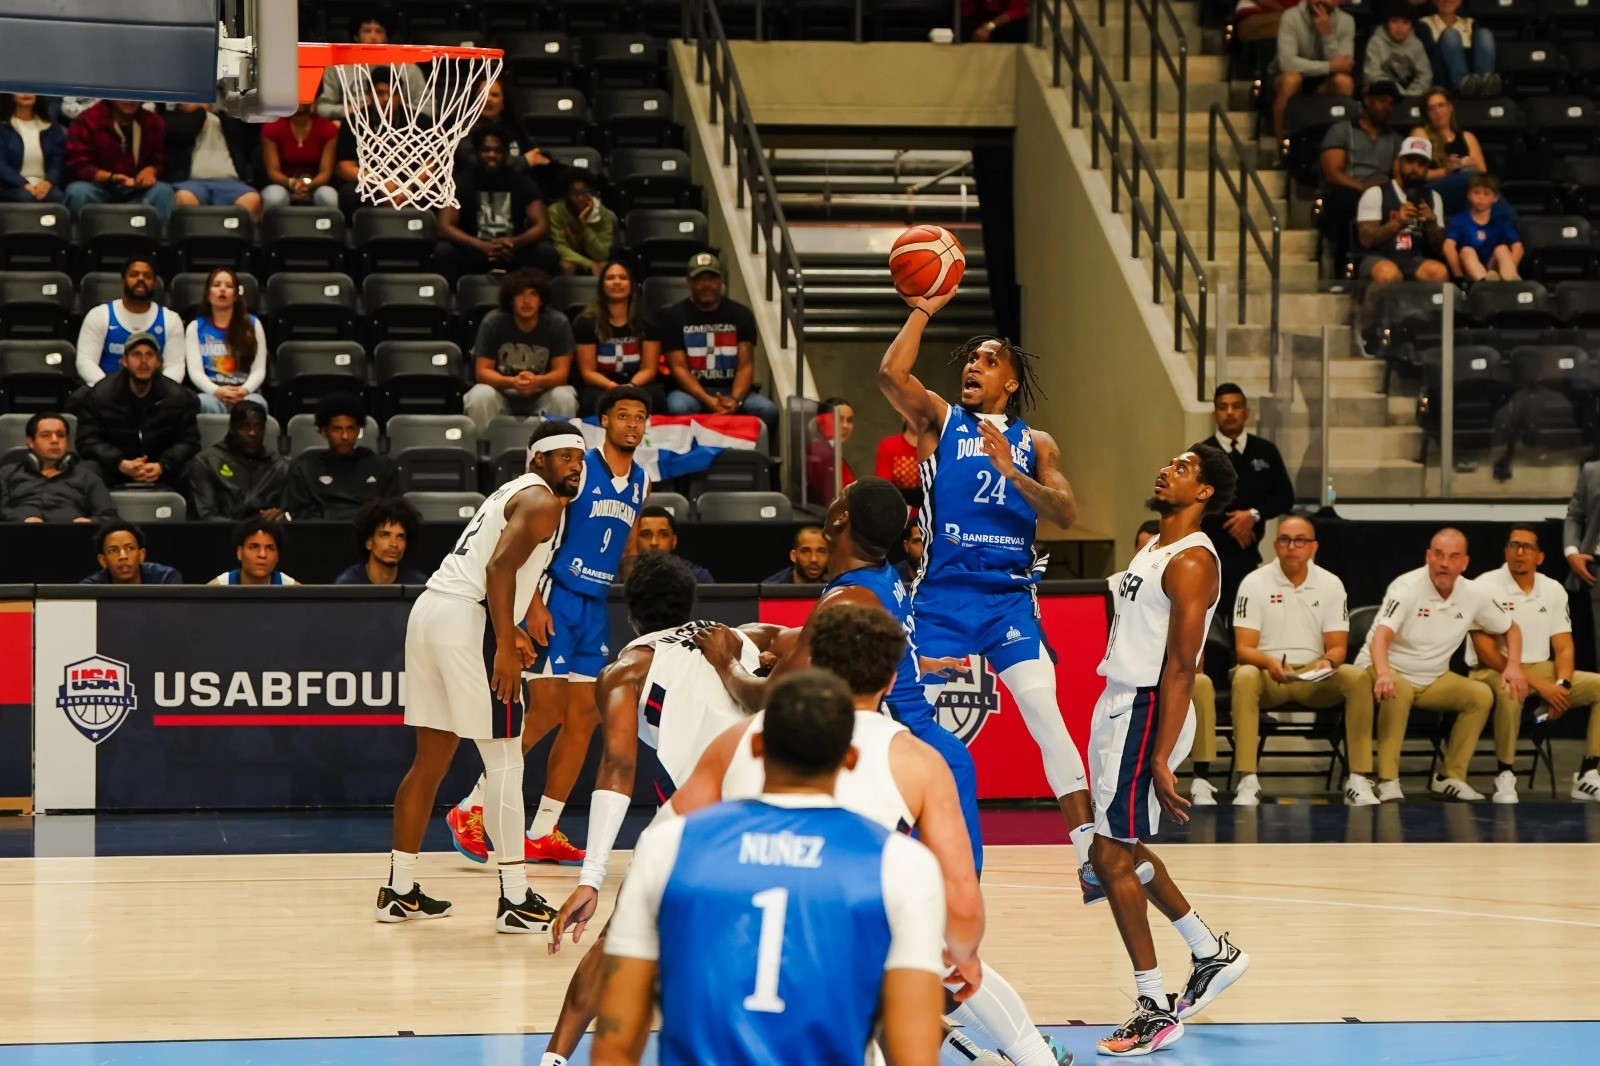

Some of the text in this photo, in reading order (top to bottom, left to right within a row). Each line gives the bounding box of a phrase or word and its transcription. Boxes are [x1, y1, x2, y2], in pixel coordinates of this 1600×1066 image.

[974, 470, 1006, 505] 24
[600, 528, 612, 553] 9
[962, 533, 1025, 545] BANRESERVAS
[1119, 572, 1143, 602] SA
[71, 669, 120, 691] USA
[738, 830, 825, 868] NUÑEZ
[743, 886, 788, 1013] 1
